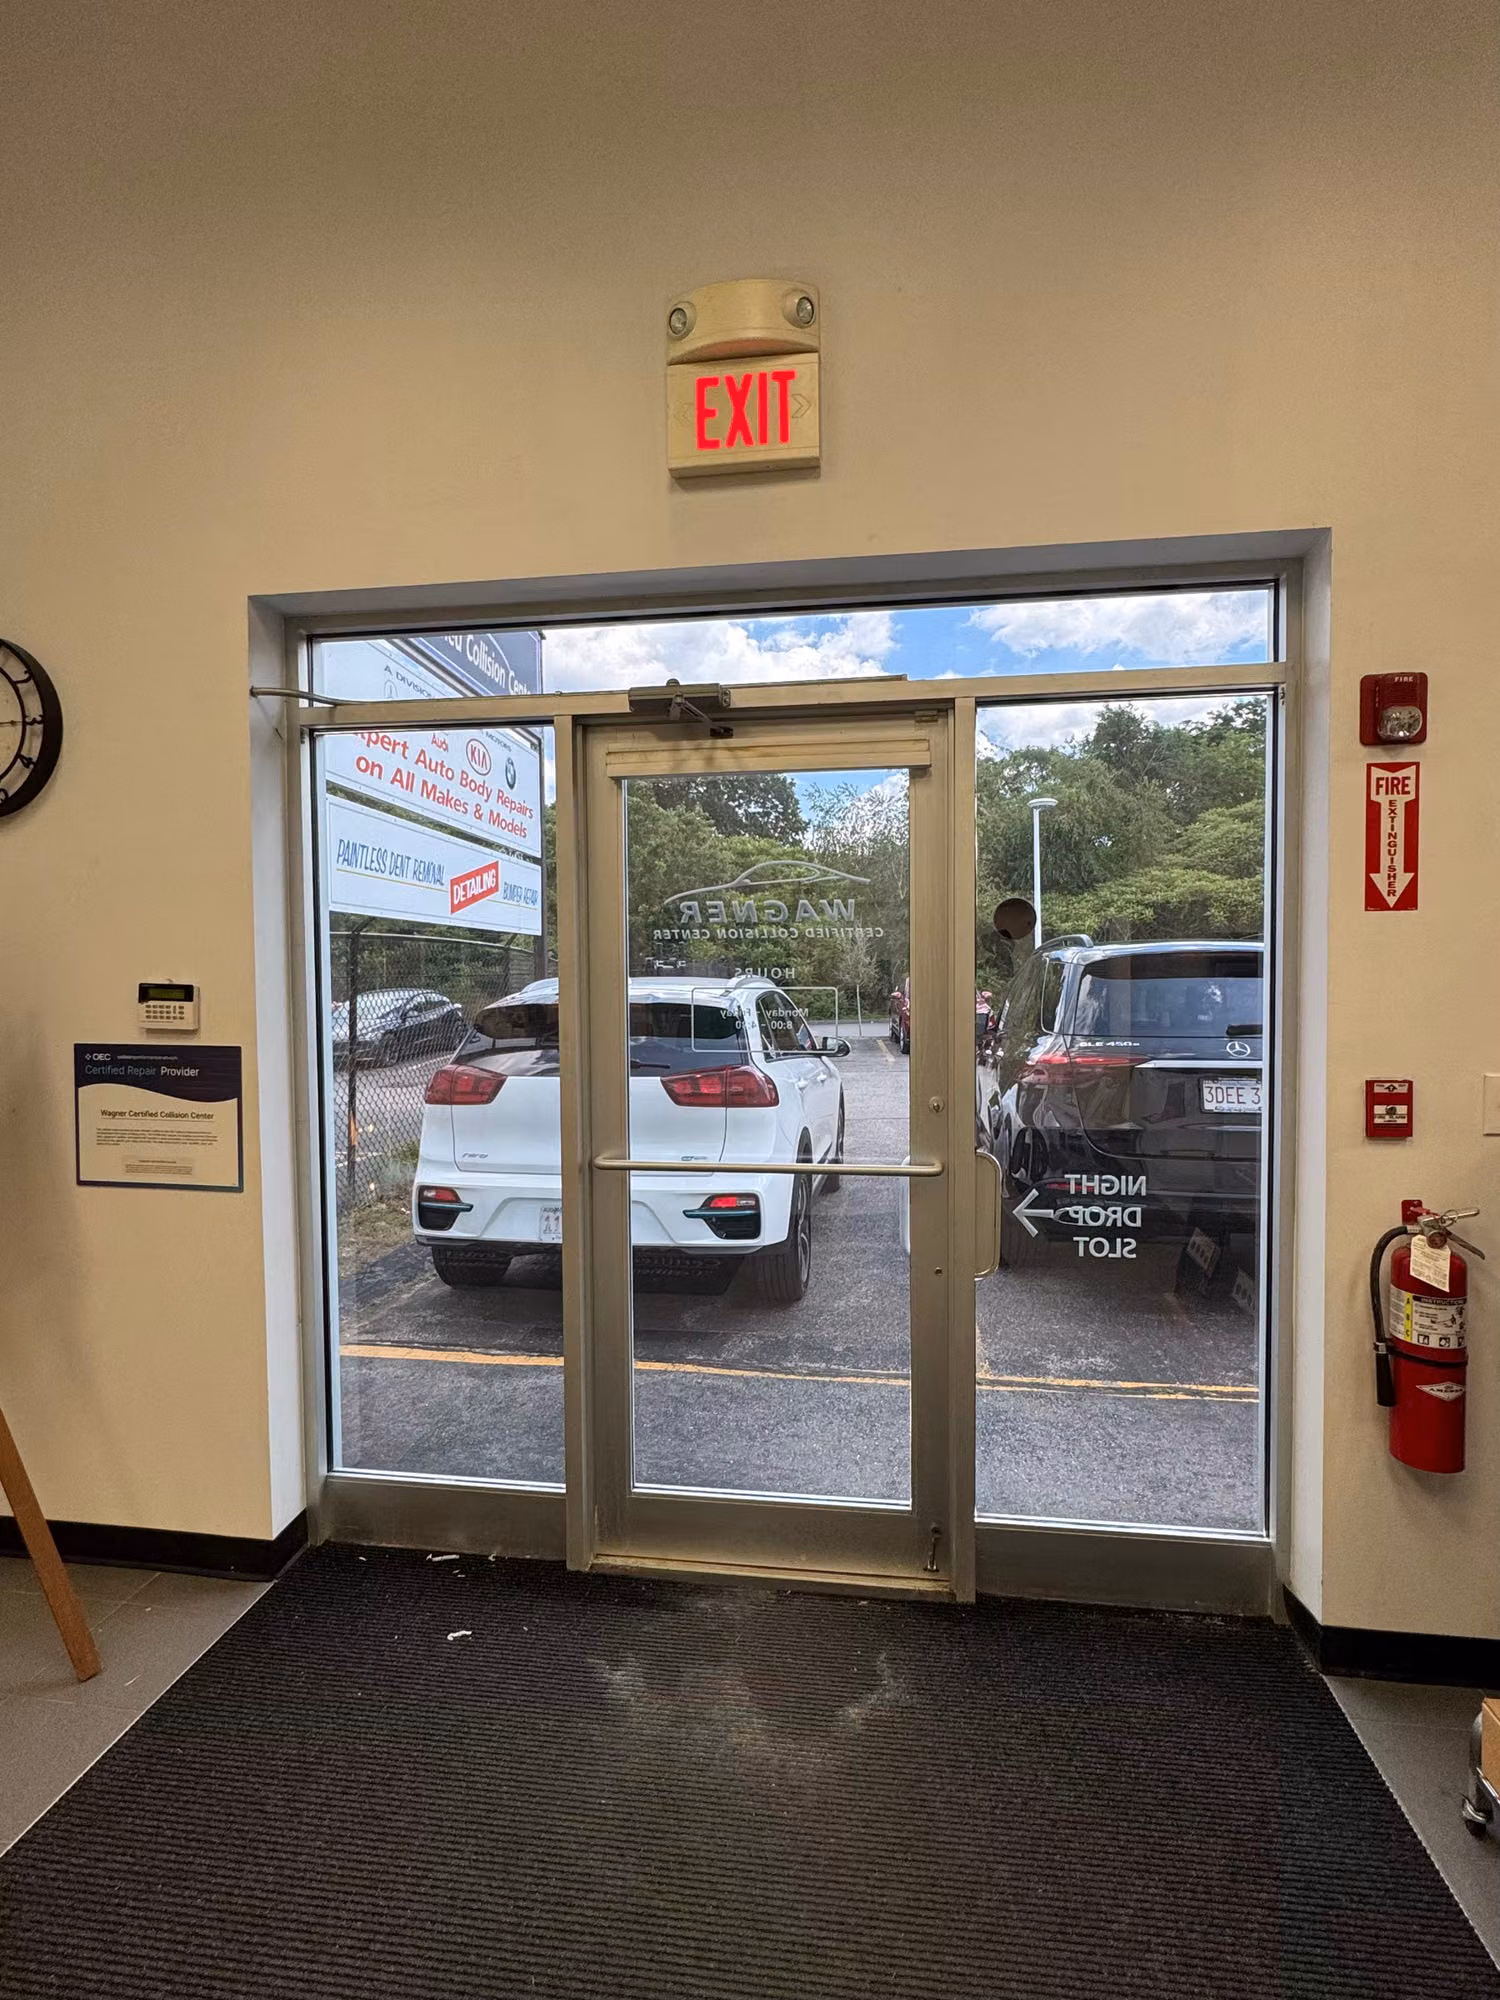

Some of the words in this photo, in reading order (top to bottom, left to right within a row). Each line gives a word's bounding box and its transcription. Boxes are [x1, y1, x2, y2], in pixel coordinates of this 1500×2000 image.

[695, 368, 797, 451] EXIT
[384, 665, 393, 676] A
[466, 634, 506, 688] Collision
[470, 743, 488, 770] KIA
[355, 755, 383, 780] on
[391, 768, 415, 793] All
[420, 778, 469, 815] Makes
[473, 803, 484, 821] &
[488, 809, 528, 839] Models
[415, 749, 455, 781] Auto
[460, 769, 492, 803] Body
[497, 789, 534, 820] Repairs
[1375, 776, 1411, 796] FIRE
[336, 839, 388, 874] PAINTLESS
[388, 852, 411, 879] DENT
[412, 859, 445, 887] REMOVAL
[1387, 800, 1398, 897] EXTINGUISHER
[453, 868, 497, 905] DETAILING
[85, 1064, 125, 1075] Certified
[127, 1065, 156, 1077] Repair
[160, 1066, 200, 1077] Provider
[1204, 1086, 1247, 1105] 3DEE
[100, 1109, 127, 1118] Wagner
[128, 1110, 158, 1118] Certified
[160, 1111, 189, 1119] Collision
[190, 1112, 214, 1120] Center
